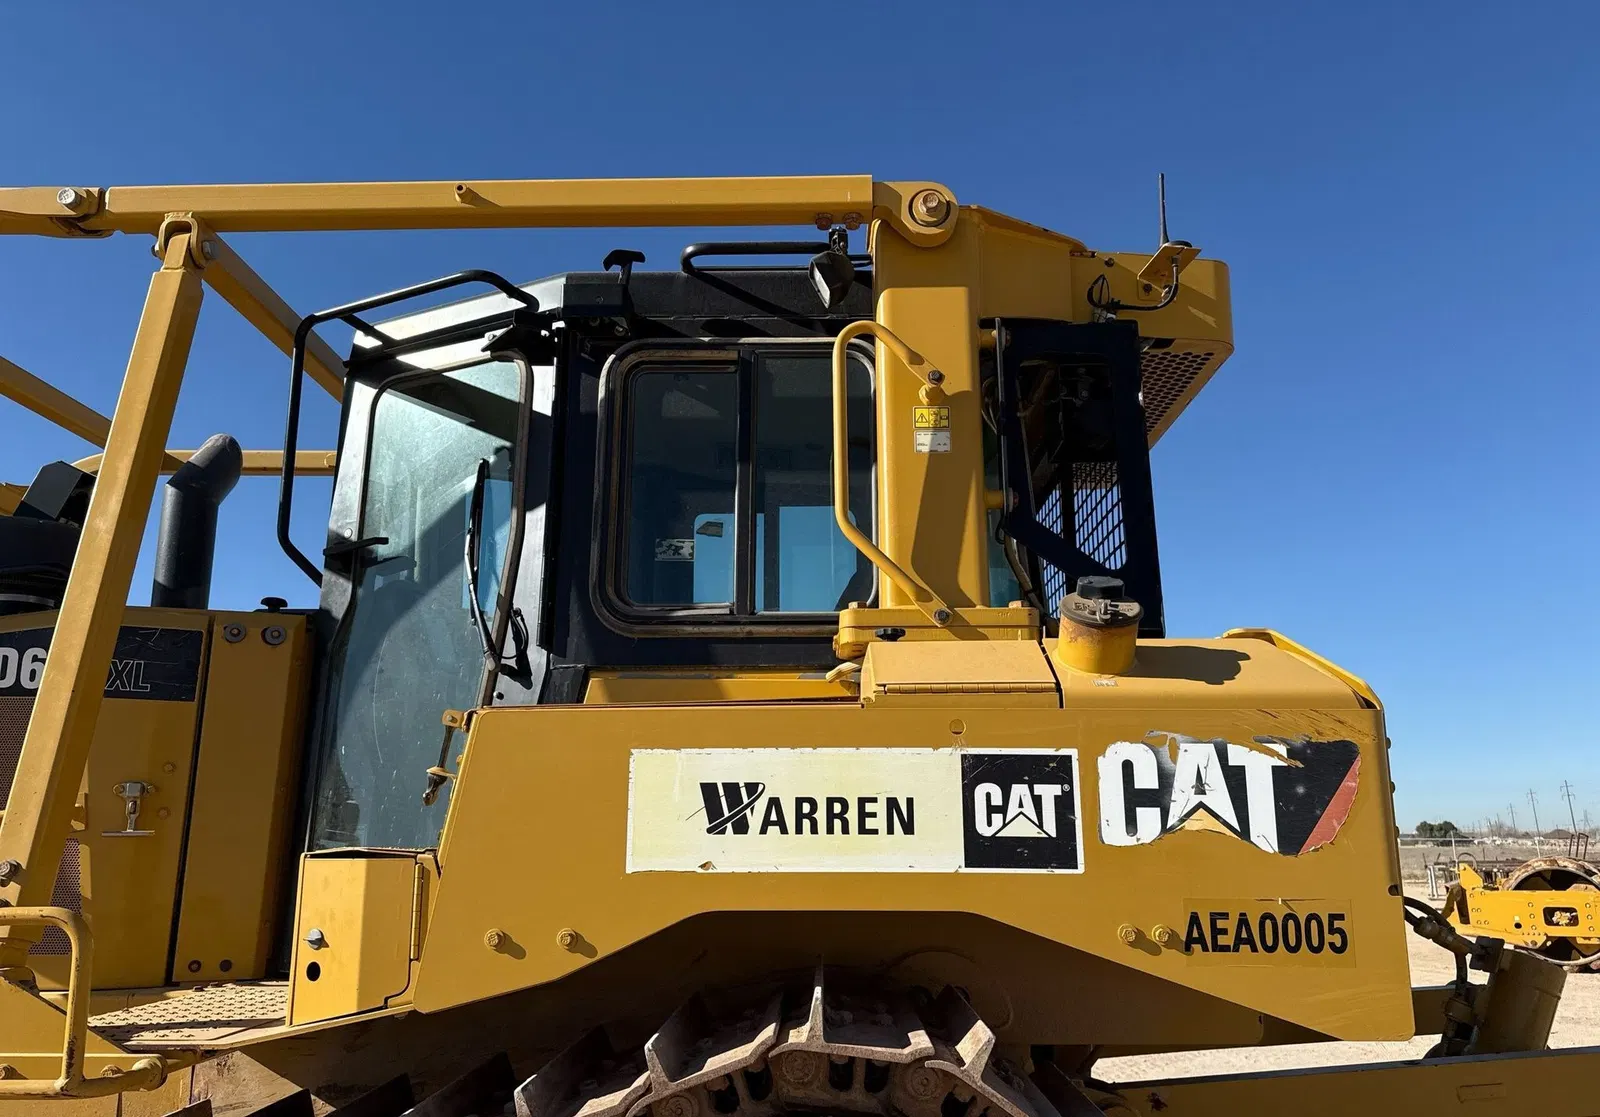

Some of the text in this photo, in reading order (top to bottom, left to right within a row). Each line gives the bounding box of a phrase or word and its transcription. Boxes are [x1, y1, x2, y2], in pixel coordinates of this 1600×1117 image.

[105, 659, 151, 692] XL
[699, 782, 915, 836] WARREN
[974, 782, 1062, 838] CAT
[1097, 740, 1288, 855] CAT
[1184, 911, 1348, 955] AEA0005
